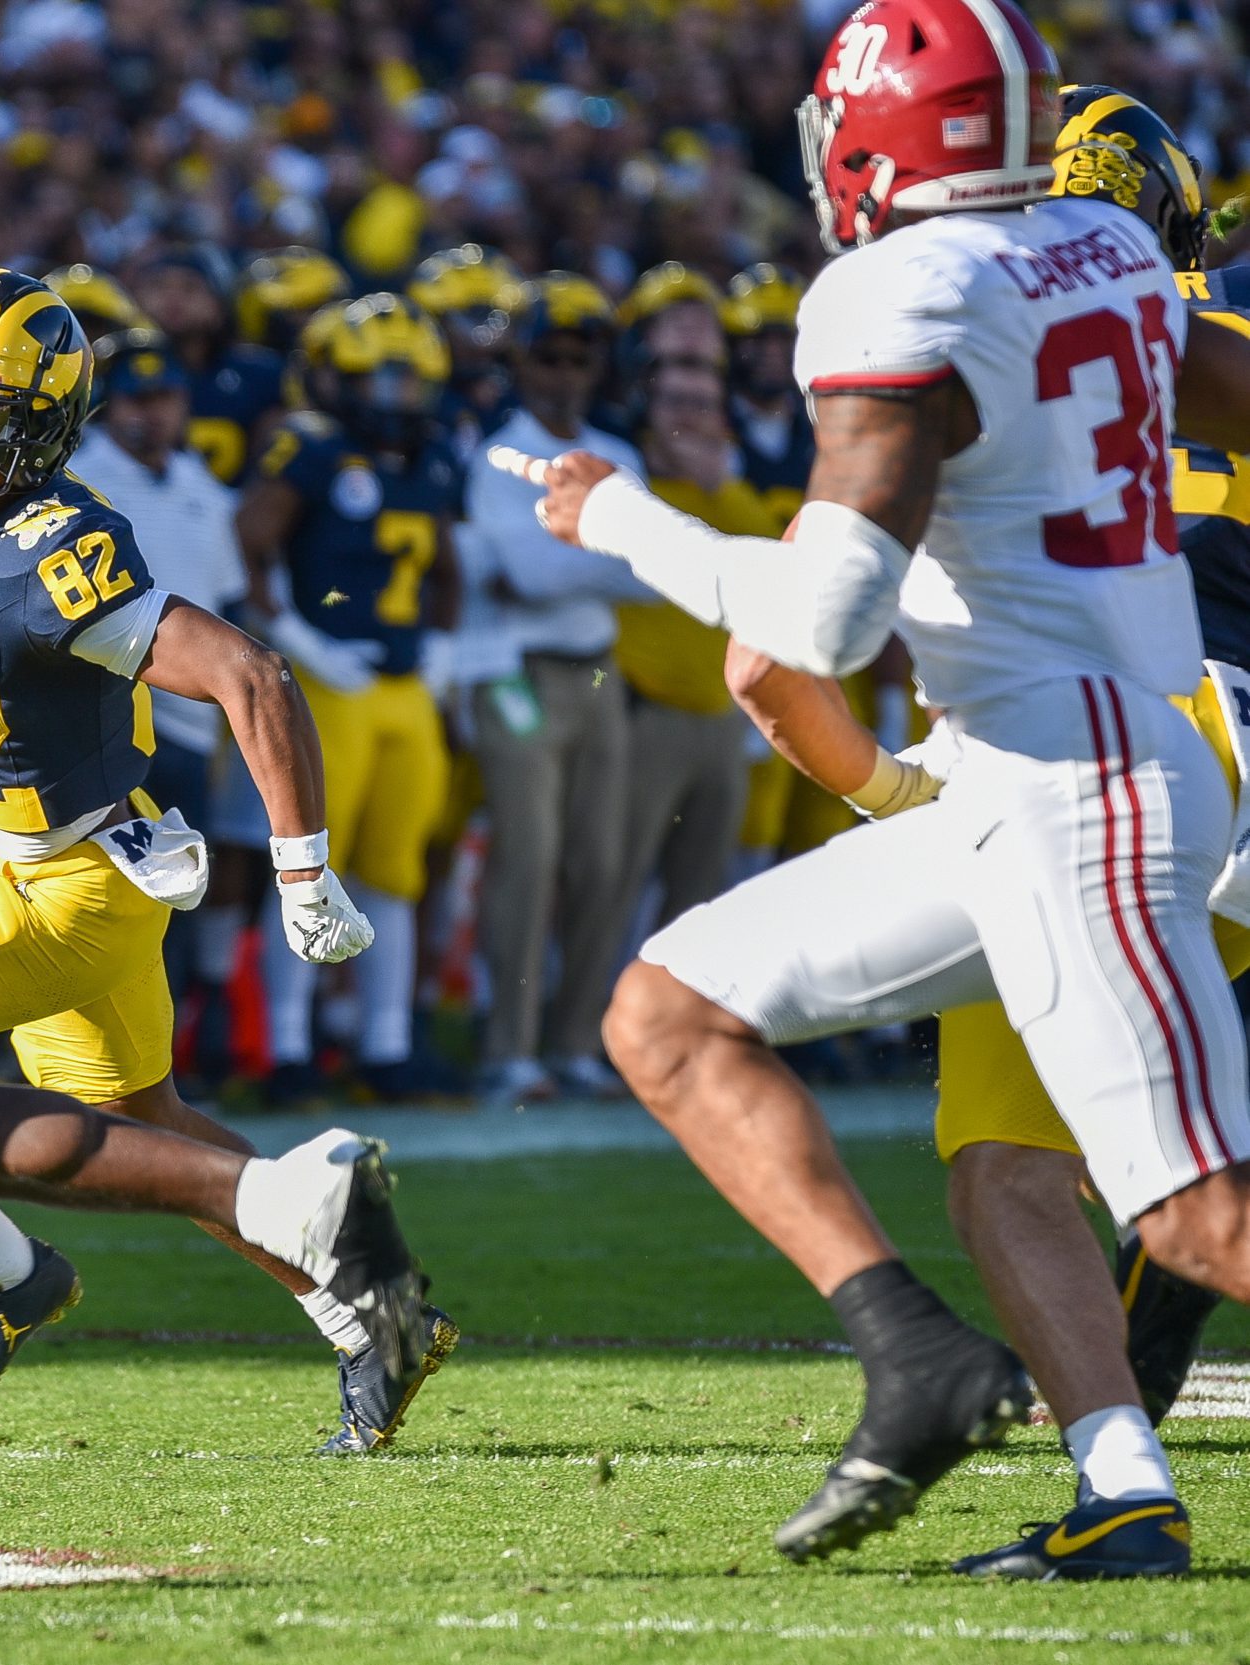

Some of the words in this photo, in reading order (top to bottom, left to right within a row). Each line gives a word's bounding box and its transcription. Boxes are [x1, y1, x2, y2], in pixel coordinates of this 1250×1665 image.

[825, 20, 888, 96] 30
[995, 220, 1159, 301] CAMPBELL
[36, 530, 136, 621] 82
[108, 819, 154, 865] M
